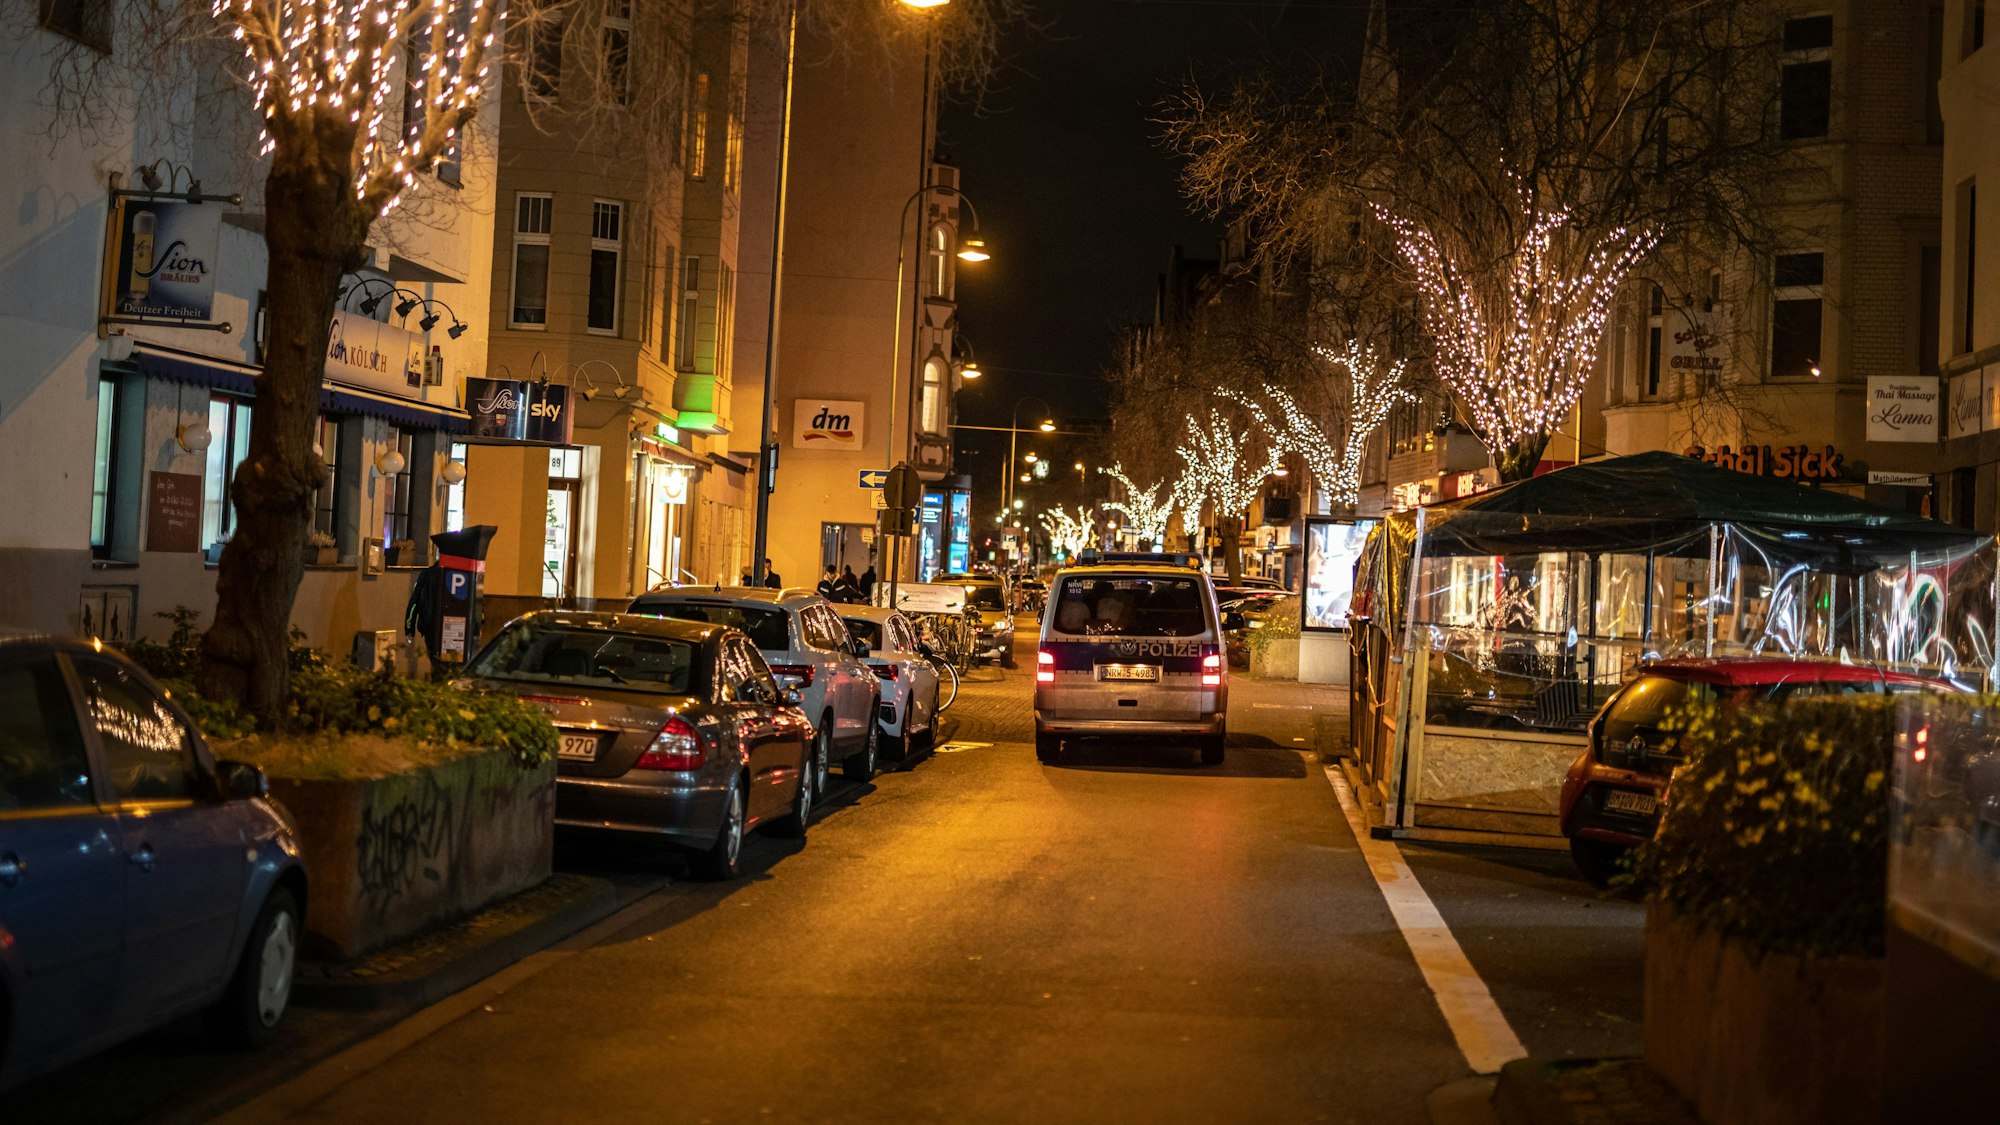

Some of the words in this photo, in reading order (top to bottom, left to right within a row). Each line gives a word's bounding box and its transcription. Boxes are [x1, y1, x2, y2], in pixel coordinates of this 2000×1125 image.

[135, 240, 208, 279] Sion
[124, 303, 162, 315] Deutzer
[164, 306, 202, 318] Freiheit
[350, 345, 388, 374] KÖLSCH
[478, 388, 526, 414] Sion
[531, 399, 561, 422] sky
[1875, 389, 1895, 400] Thai
[1897, 390, 1937, 402] Massage
[812, 408, 850, 430] dm
[1871, 403, 1935, 430] Lanna
[551, 458, 561, 468] 89
[1773, 445, 1840, 478] Sick
[451, 574, 466, 595] P
[1138, 643, 1203, 657] POLIZEI
[1106, 668, 1121, 677] NRW
[565, 737, 594, 755] 970
